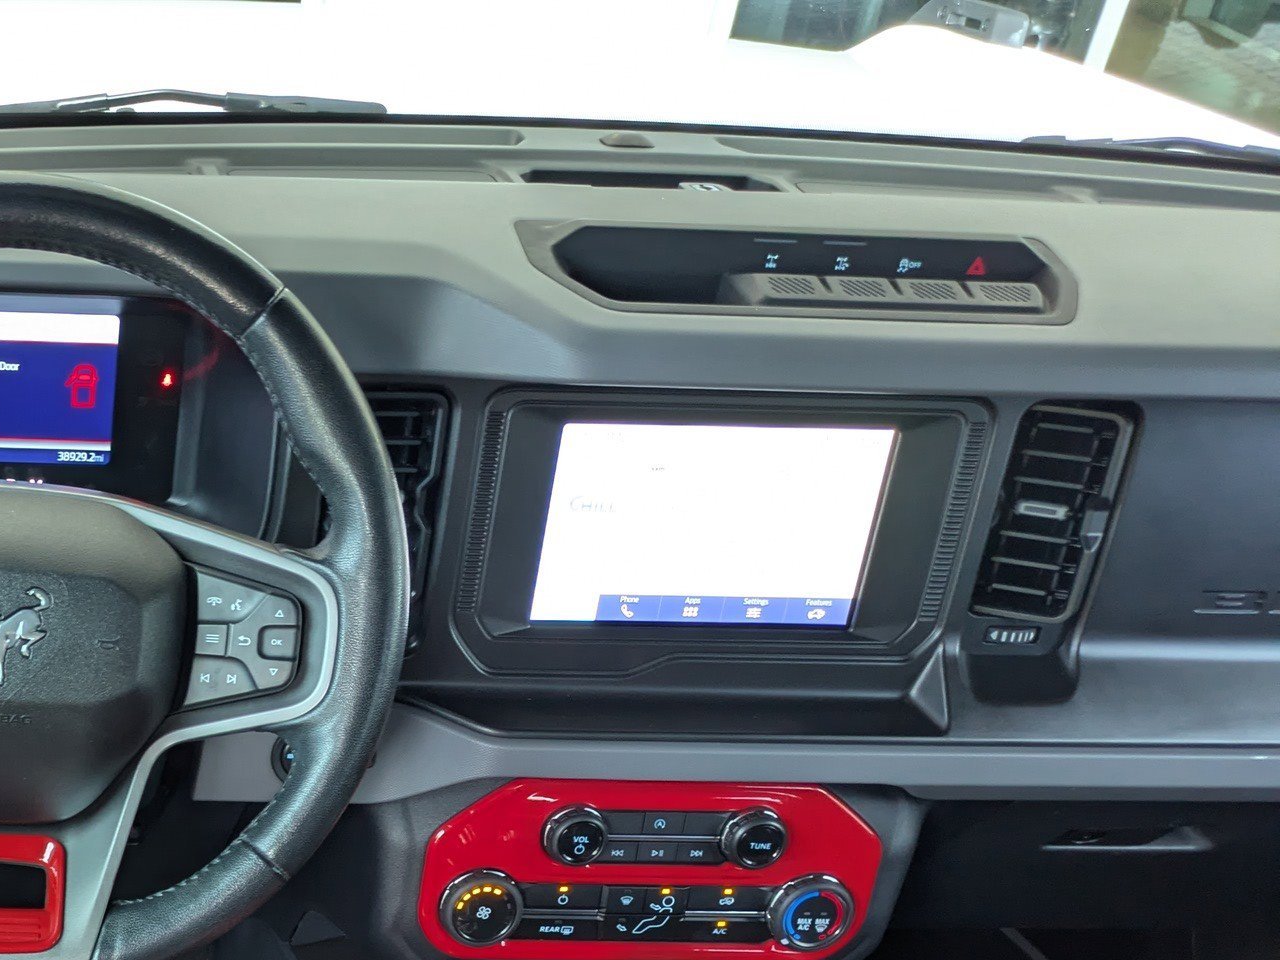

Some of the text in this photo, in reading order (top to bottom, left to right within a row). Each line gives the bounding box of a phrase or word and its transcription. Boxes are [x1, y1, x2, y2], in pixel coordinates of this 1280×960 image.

[908, 261, 922, 269] OFF
[0, 361, 20, 371] Door
[620, 595, 640, 604] Phone
[684, 596, 701, 605] Apps
[743, 597, 769, 607] Settings
[805, 598, 833, 607] Features
[270, 638, 282, 647] OK
[573, 835, 590, 843] VOL
[750, 842, 772, 850] TUNE
[797, 917, 812, 925] MAX
[539, 925, 560, 934] REAR
